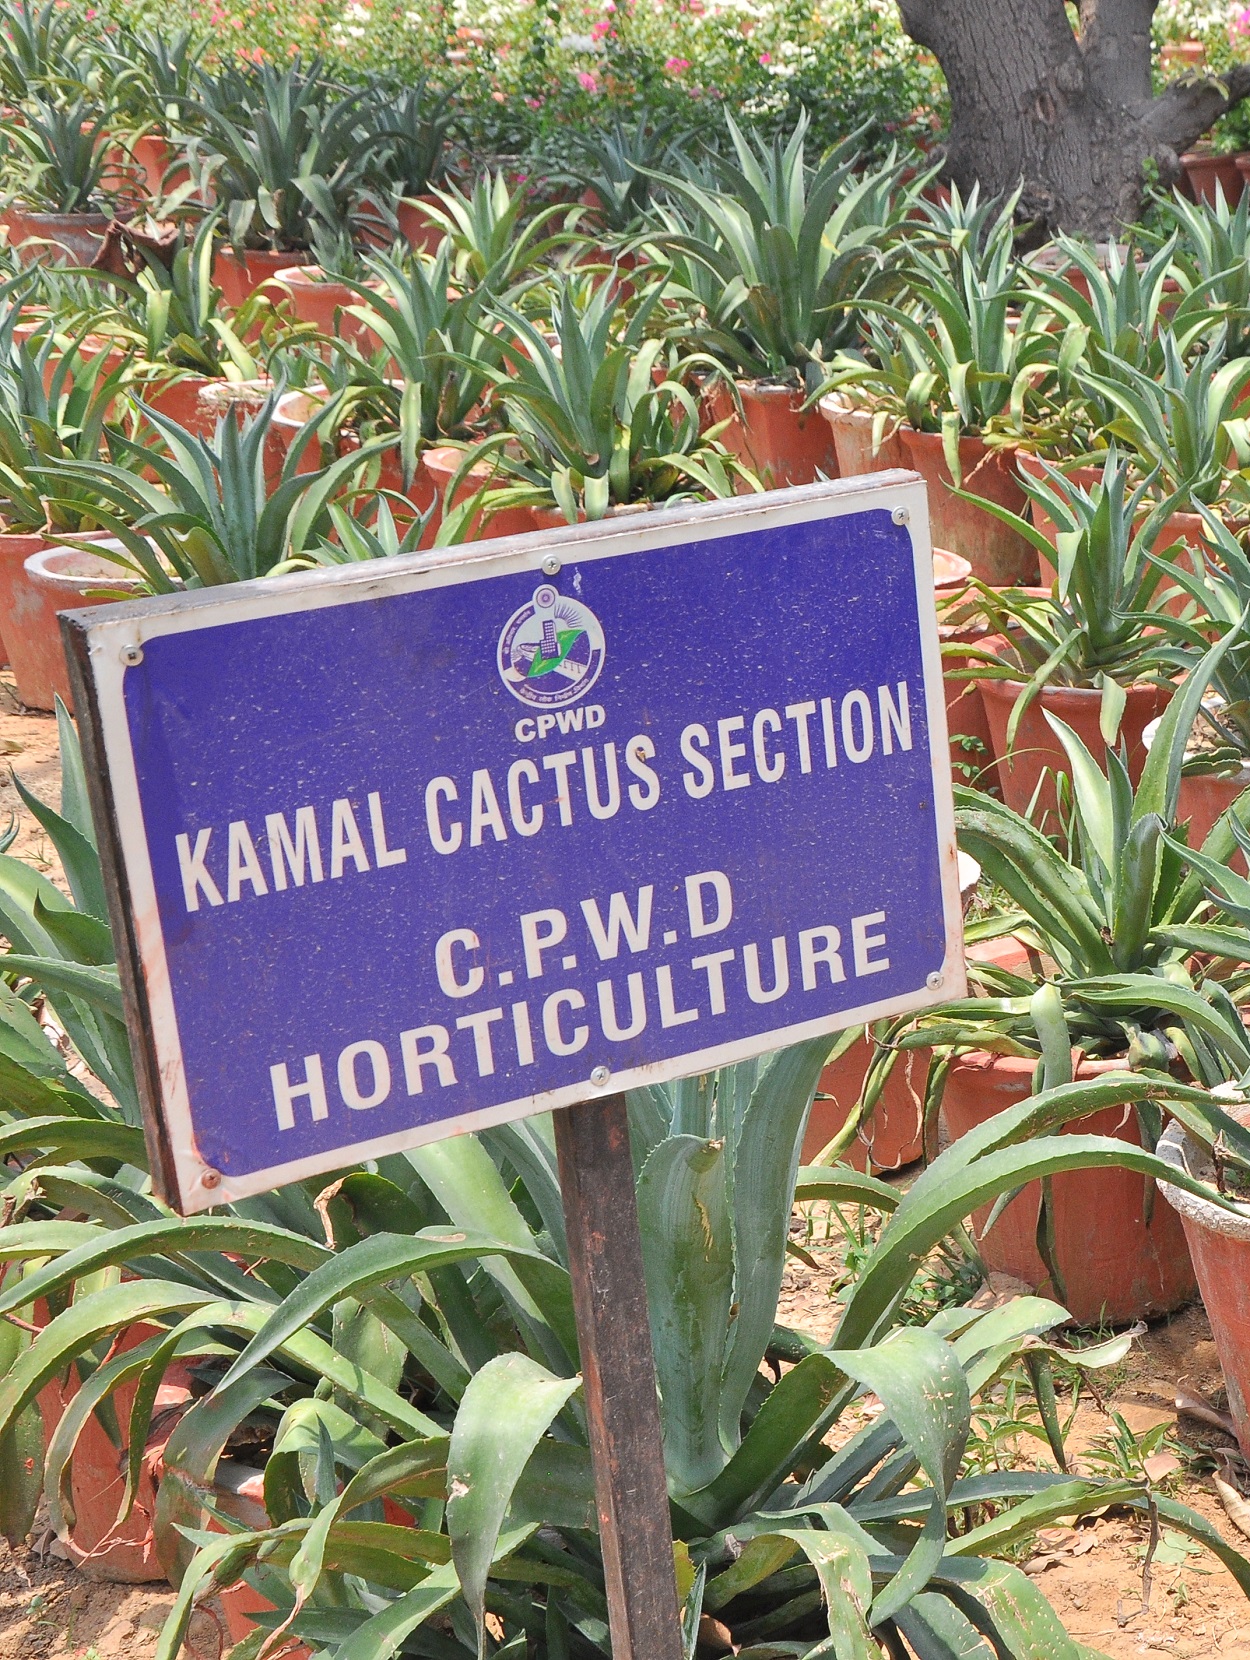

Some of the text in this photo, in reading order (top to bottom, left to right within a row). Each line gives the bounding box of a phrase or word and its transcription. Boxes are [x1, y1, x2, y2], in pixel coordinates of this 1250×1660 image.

[175, 681, 914, 913] KAMAL CACTUS SECTION
[514, 704, 606, 743] CPWD
[269, 910, 890, 1132] HORTICULTURE
[434, 870, 733, 999] C.P.W.D
